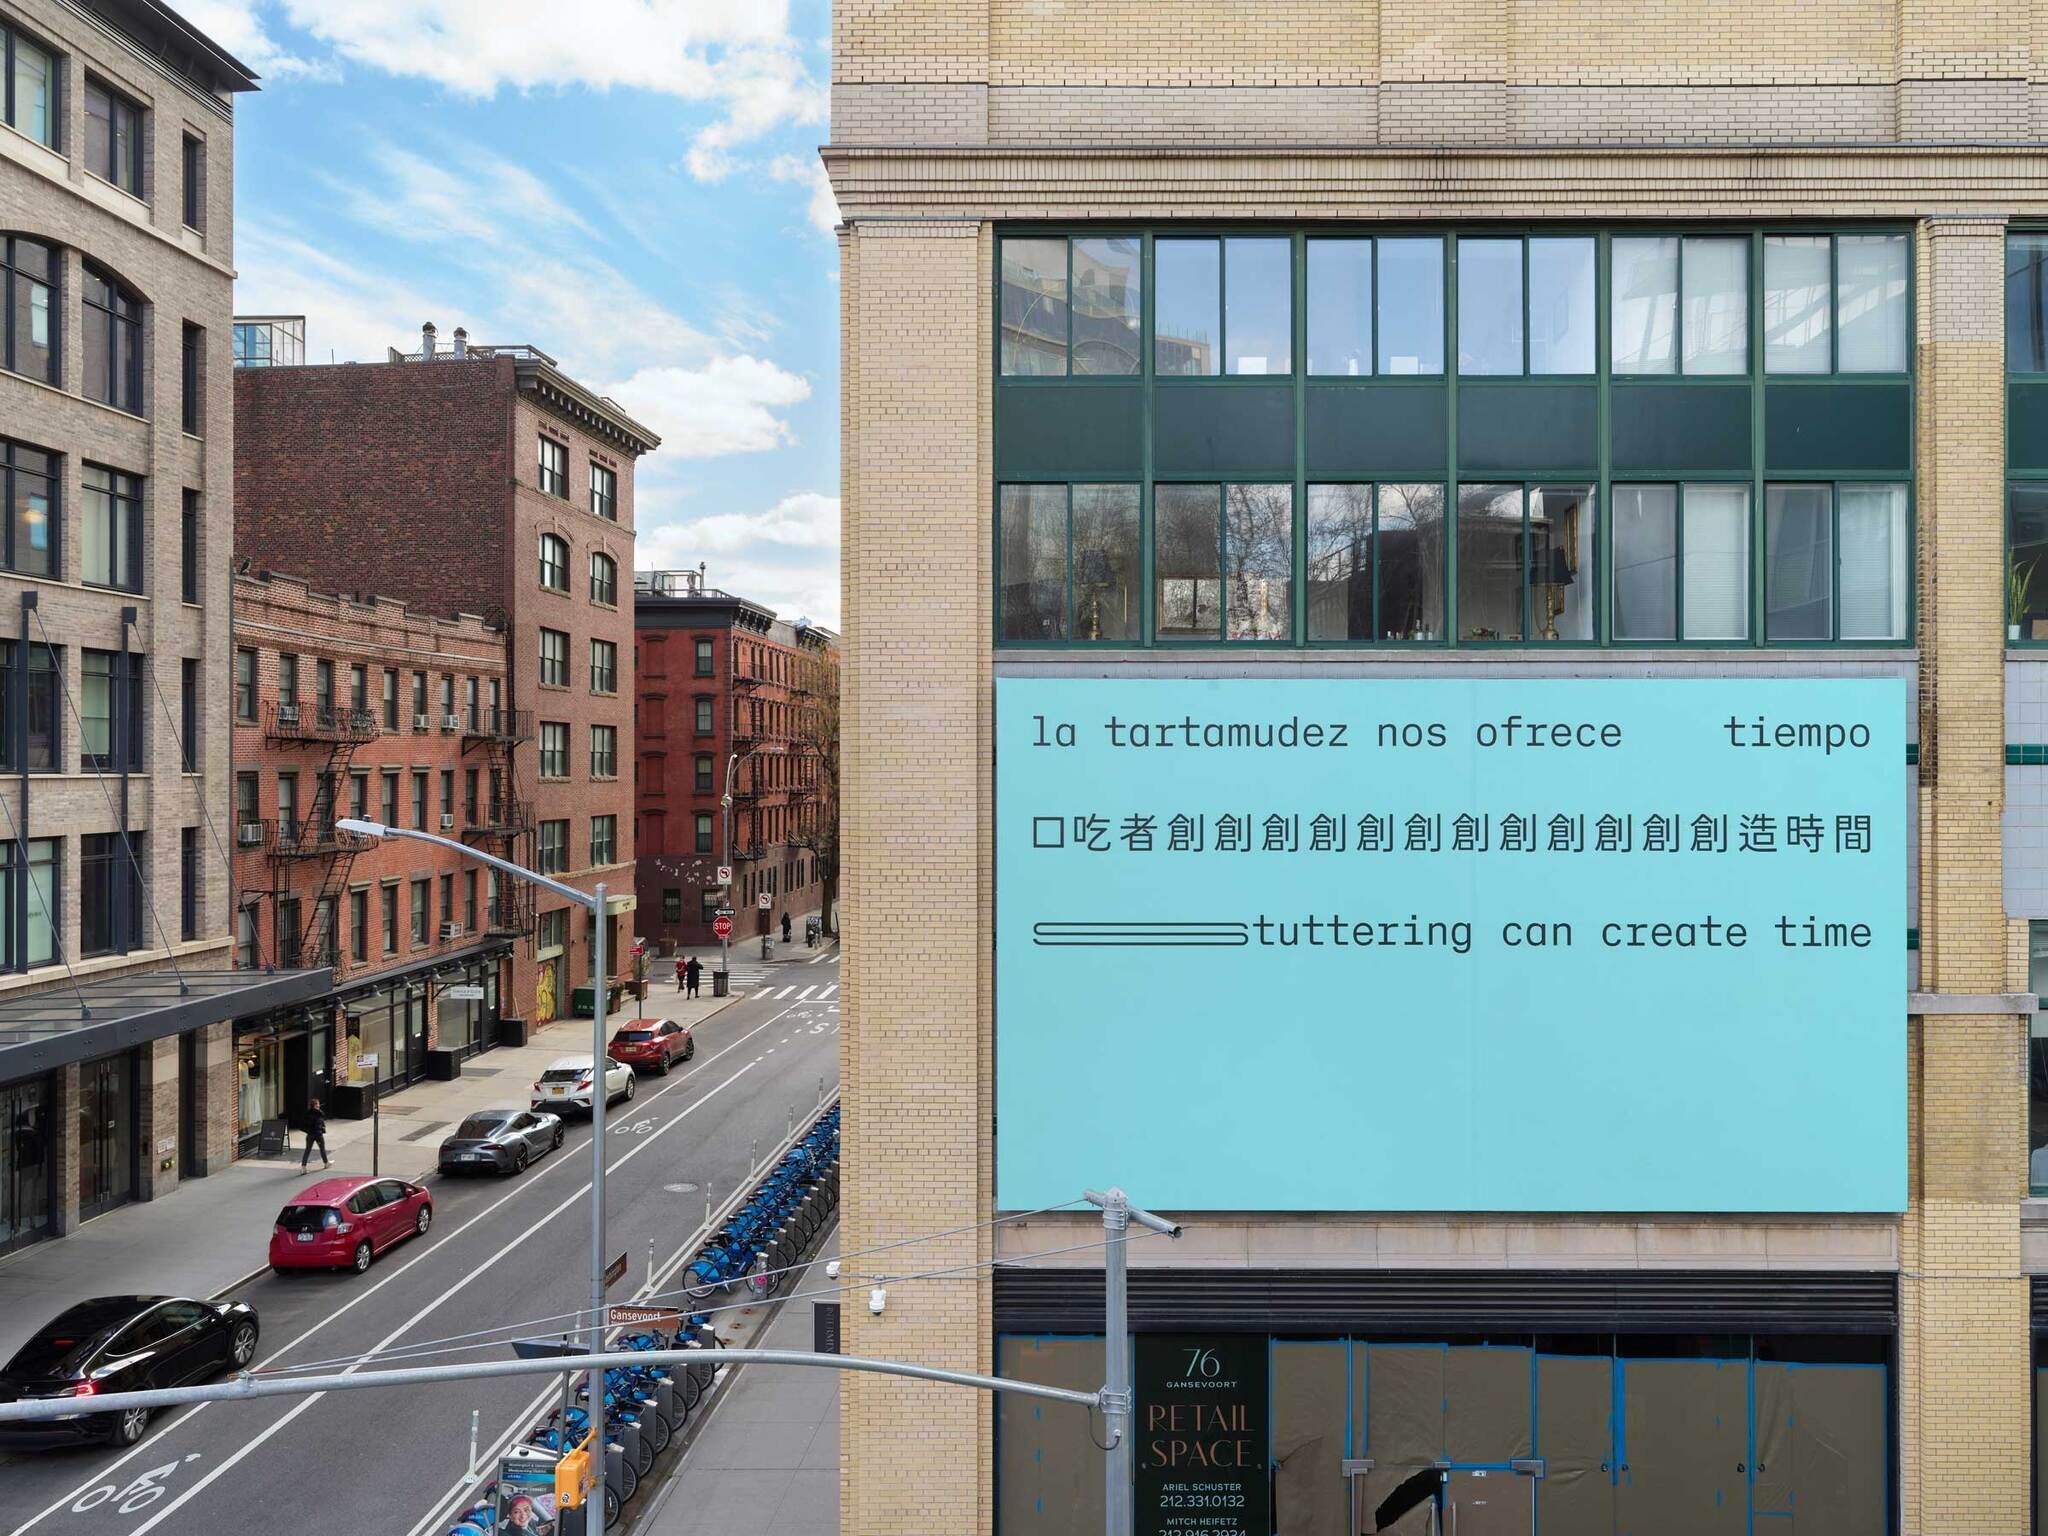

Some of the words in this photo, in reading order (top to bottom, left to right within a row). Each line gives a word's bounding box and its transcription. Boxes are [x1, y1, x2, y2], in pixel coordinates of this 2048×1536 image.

[1033, 715, 1075, 747] la
[1104, 715, 1348, 747] tartamudez
[1378, 722, 1447, 747] nos
[1476, 715, 1622, 747] ofrece
[1724, 715, 1871, 755] tiempo
[714, 921, 731, 931] STOP
[1502, 922, 1572, 947] can
[1602, 915, 1747, 947] create
[1774, 915, 1872, 948] time
[610, 1309, 662, 1321] Gansevoort
[1182, 1347, 1221, 1378] 76
[1166, 1381, 1238, 1389] GANSEVOORT
[1148, 1404, 1256, 1432] RETAIL
[1151, 1439, 1251, 1468] SPACE
[1162, 1483, 1189, 1491] ARIEL
[1192, 1483, 1242, 1491] SCHUSTER
[1160, 1495, 1245, 1508] 212.331.0132
[1166, 1517, 1197, 1526] MITCH
[1199, 1517, 1238, 1526] HEIFETZ
